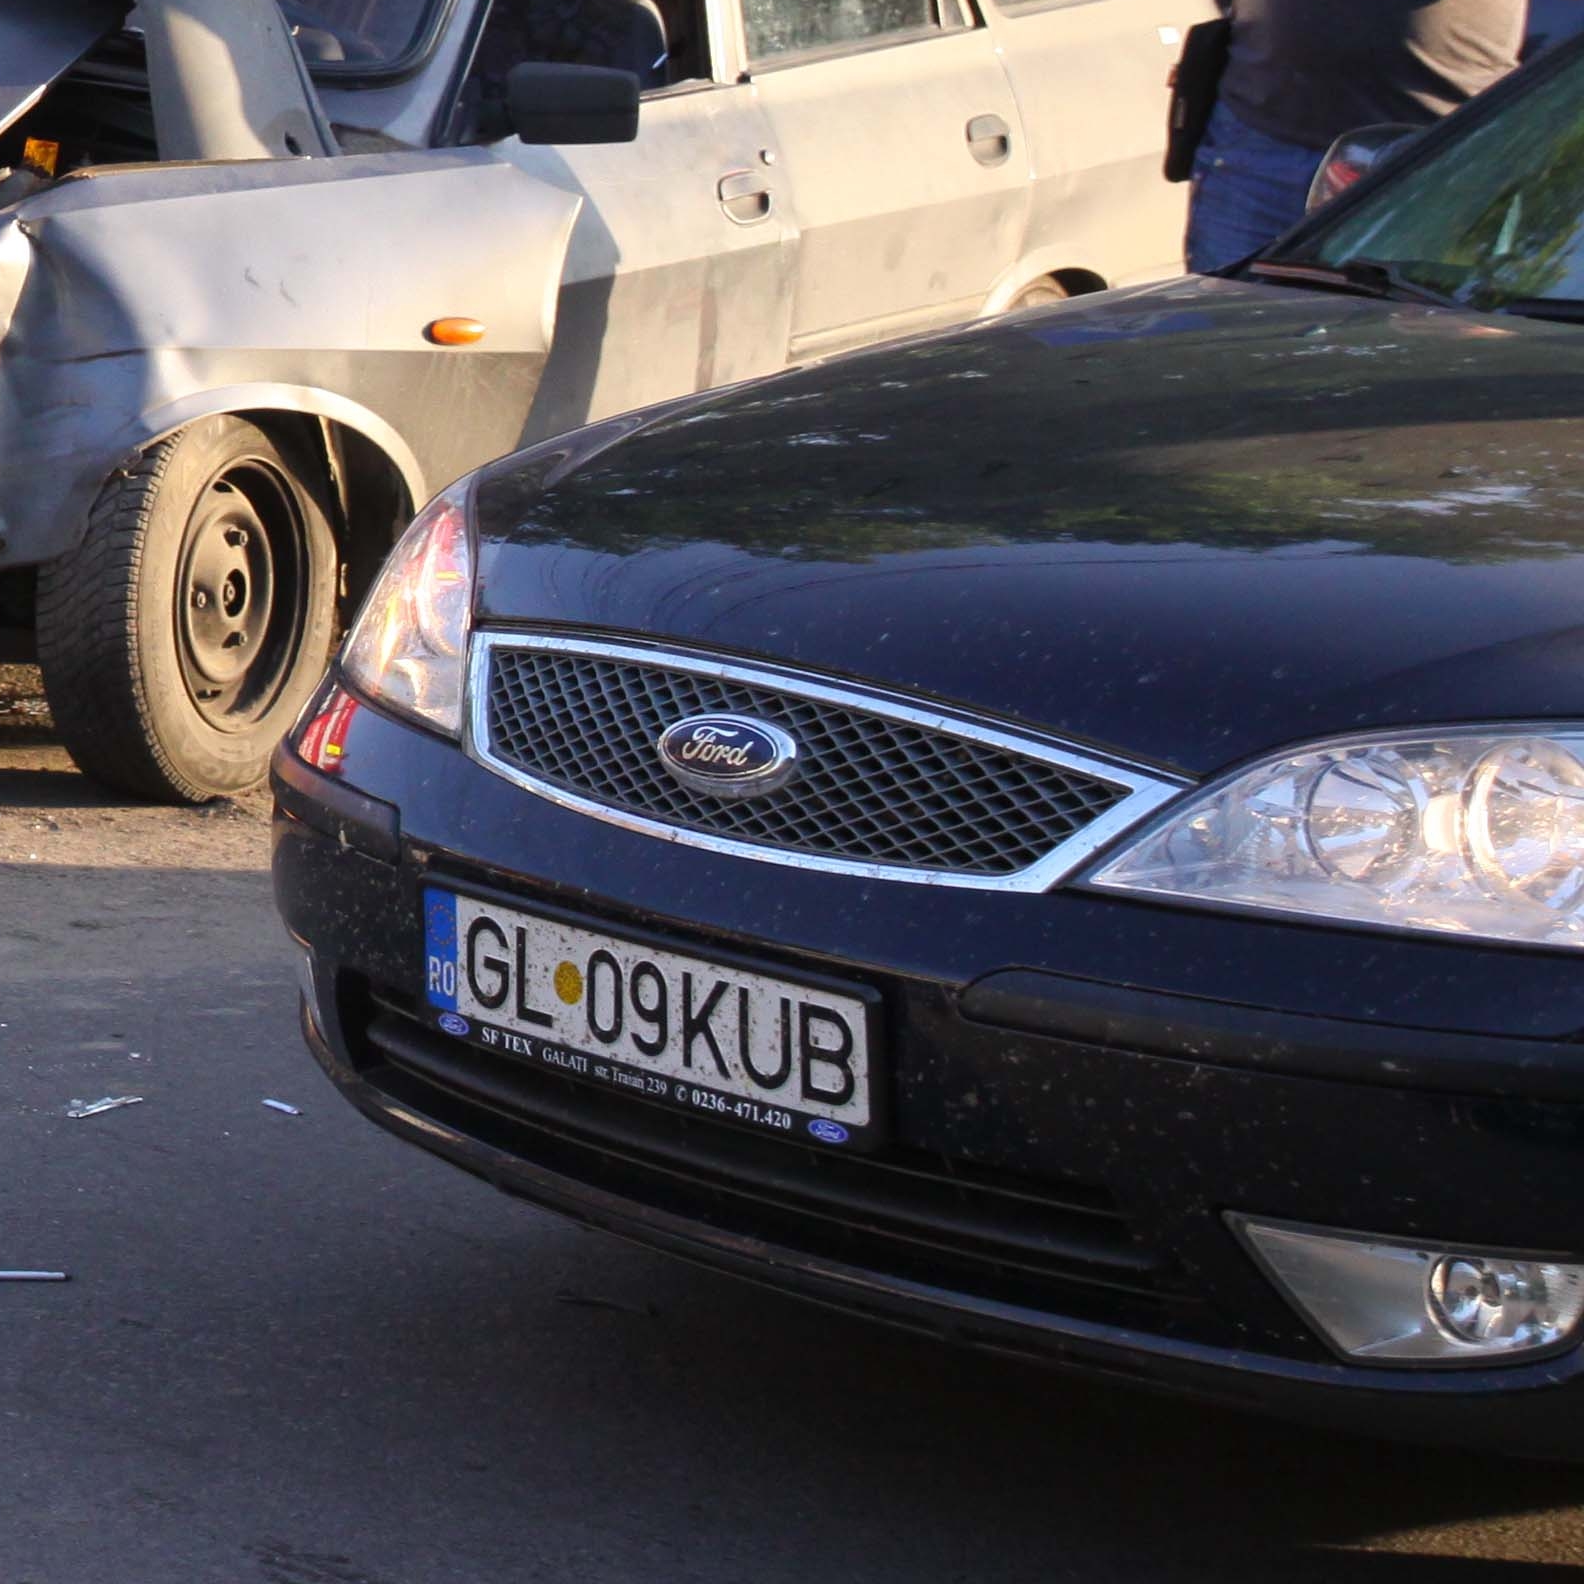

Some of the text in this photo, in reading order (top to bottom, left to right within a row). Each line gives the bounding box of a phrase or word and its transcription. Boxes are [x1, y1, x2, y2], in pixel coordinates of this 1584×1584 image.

[682, 726, 754, 766] Ford
[429, 956, 456, 997] RO
[467, 916, 553, 1028] GL
[481, 1026, 499, 1045] SF
[502, 1032, 532, 1056] TEX
[647, 1077, 667, 1095] 239
[691, 1089, 792, 1130] 0236-471.420
